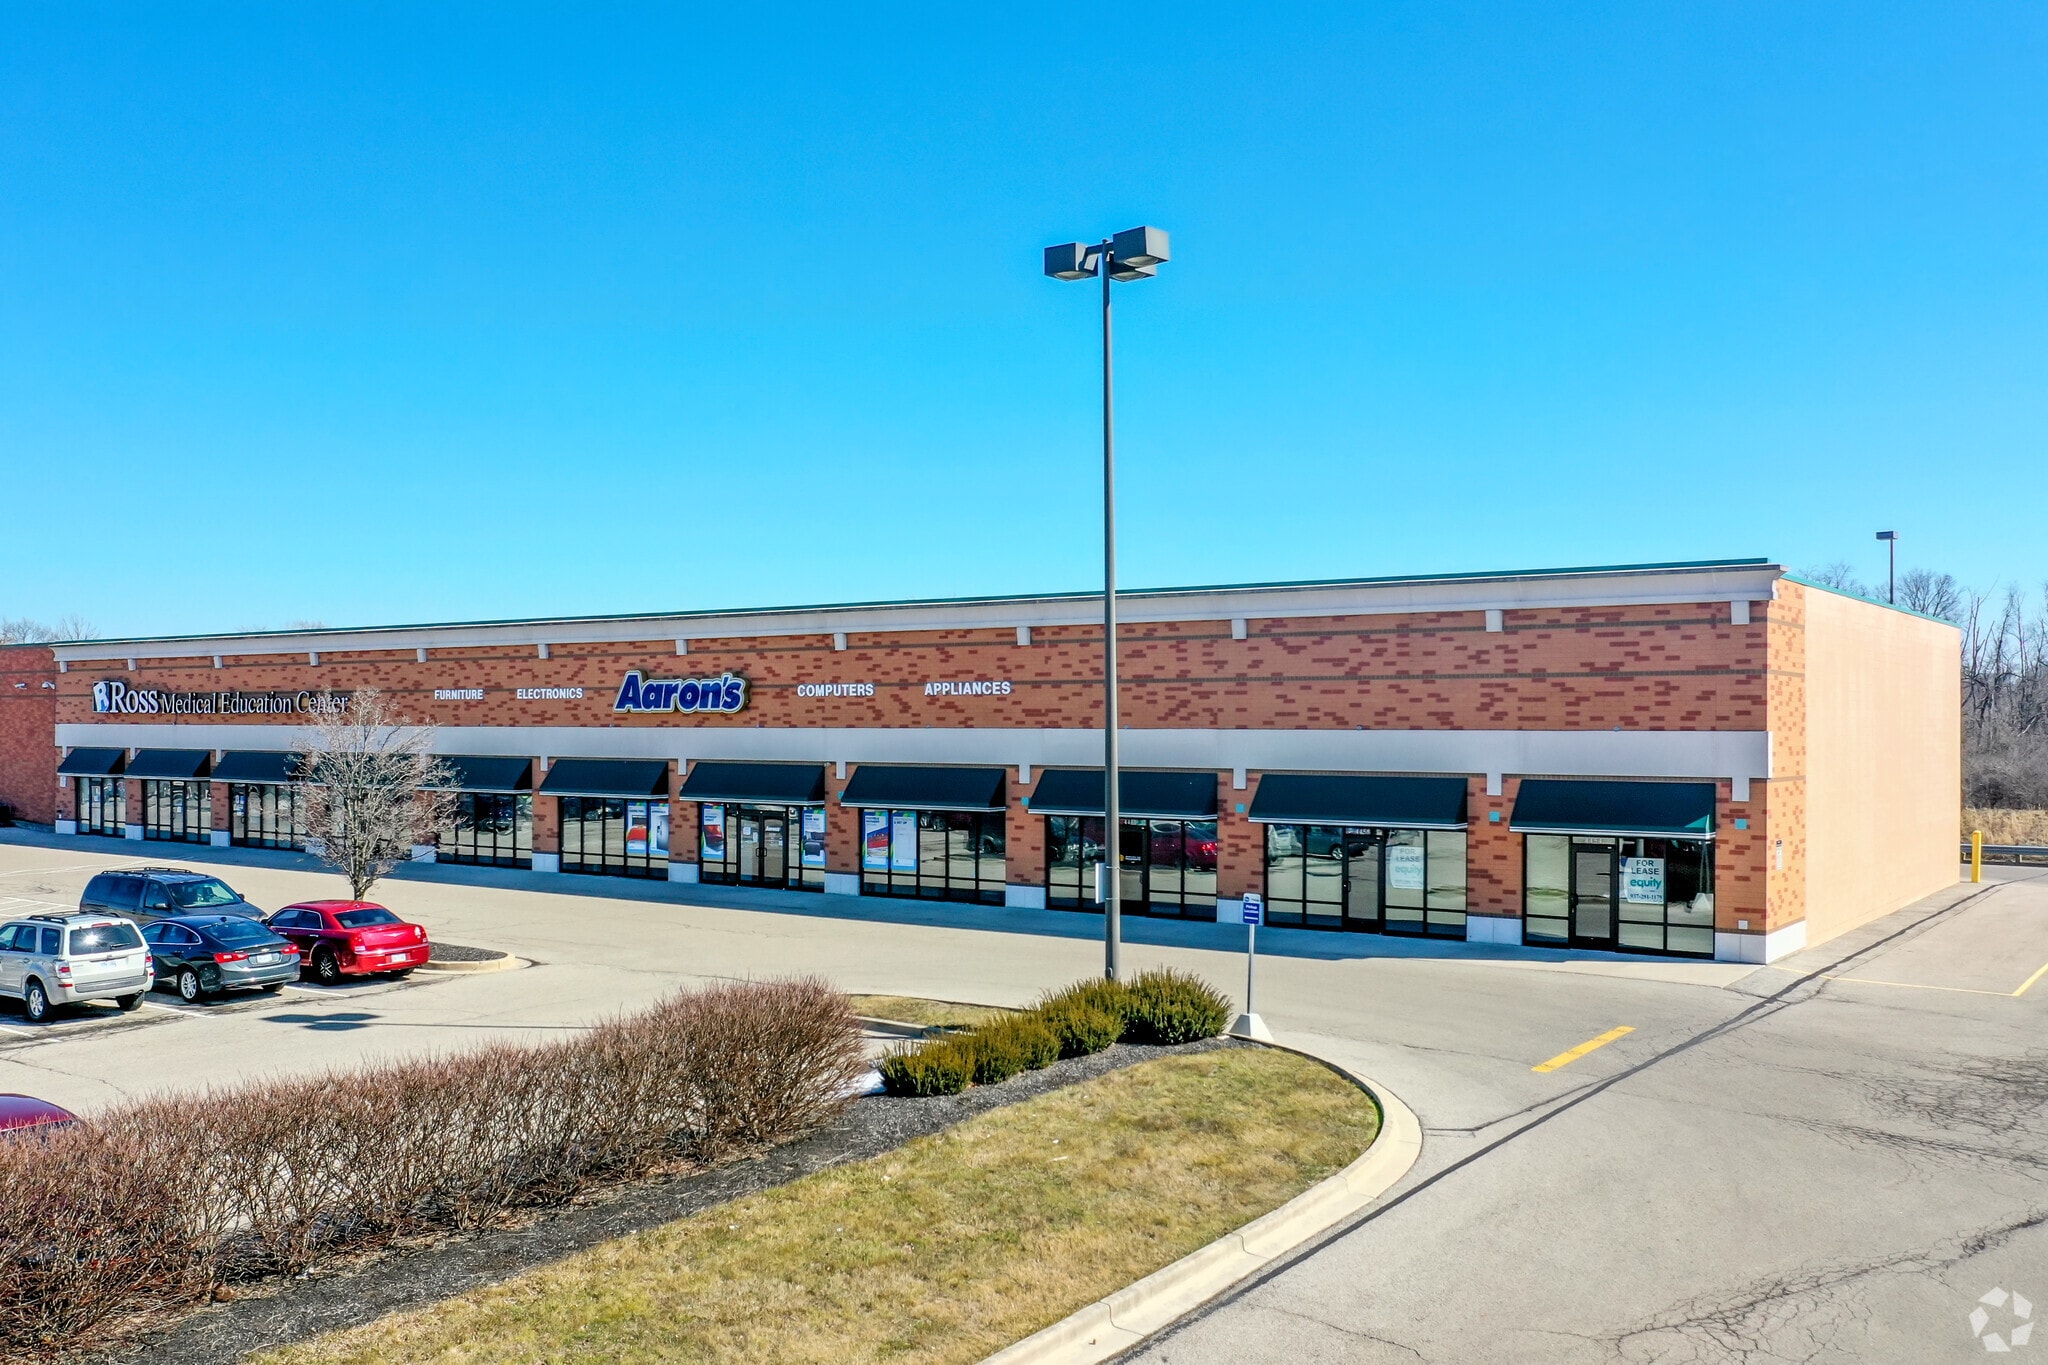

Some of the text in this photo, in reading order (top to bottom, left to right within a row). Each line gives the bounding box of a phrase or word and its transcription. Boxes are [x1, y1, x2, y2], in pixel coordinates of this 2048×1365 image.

[434, 688, 484, 701] FURNITURE
[516, 687, 583, 700] ELECTRONICS
[614, 670, 745, 714] Aaron's
[797, 682, 875, 698] COMPUTERS
[924, 681, 1012, 696] APPLIANCES
[161, 692, 216, 714] Medical
[220, 691, 291, 714] Education
[295, 690, 349, 714] Center
[1395, 863, 1423, 875] equity
[1636, 859, 1654, 867] FOR
[1631, 867, 1660, 875] LEASE
[1629, 876, 1662, 890] equity
